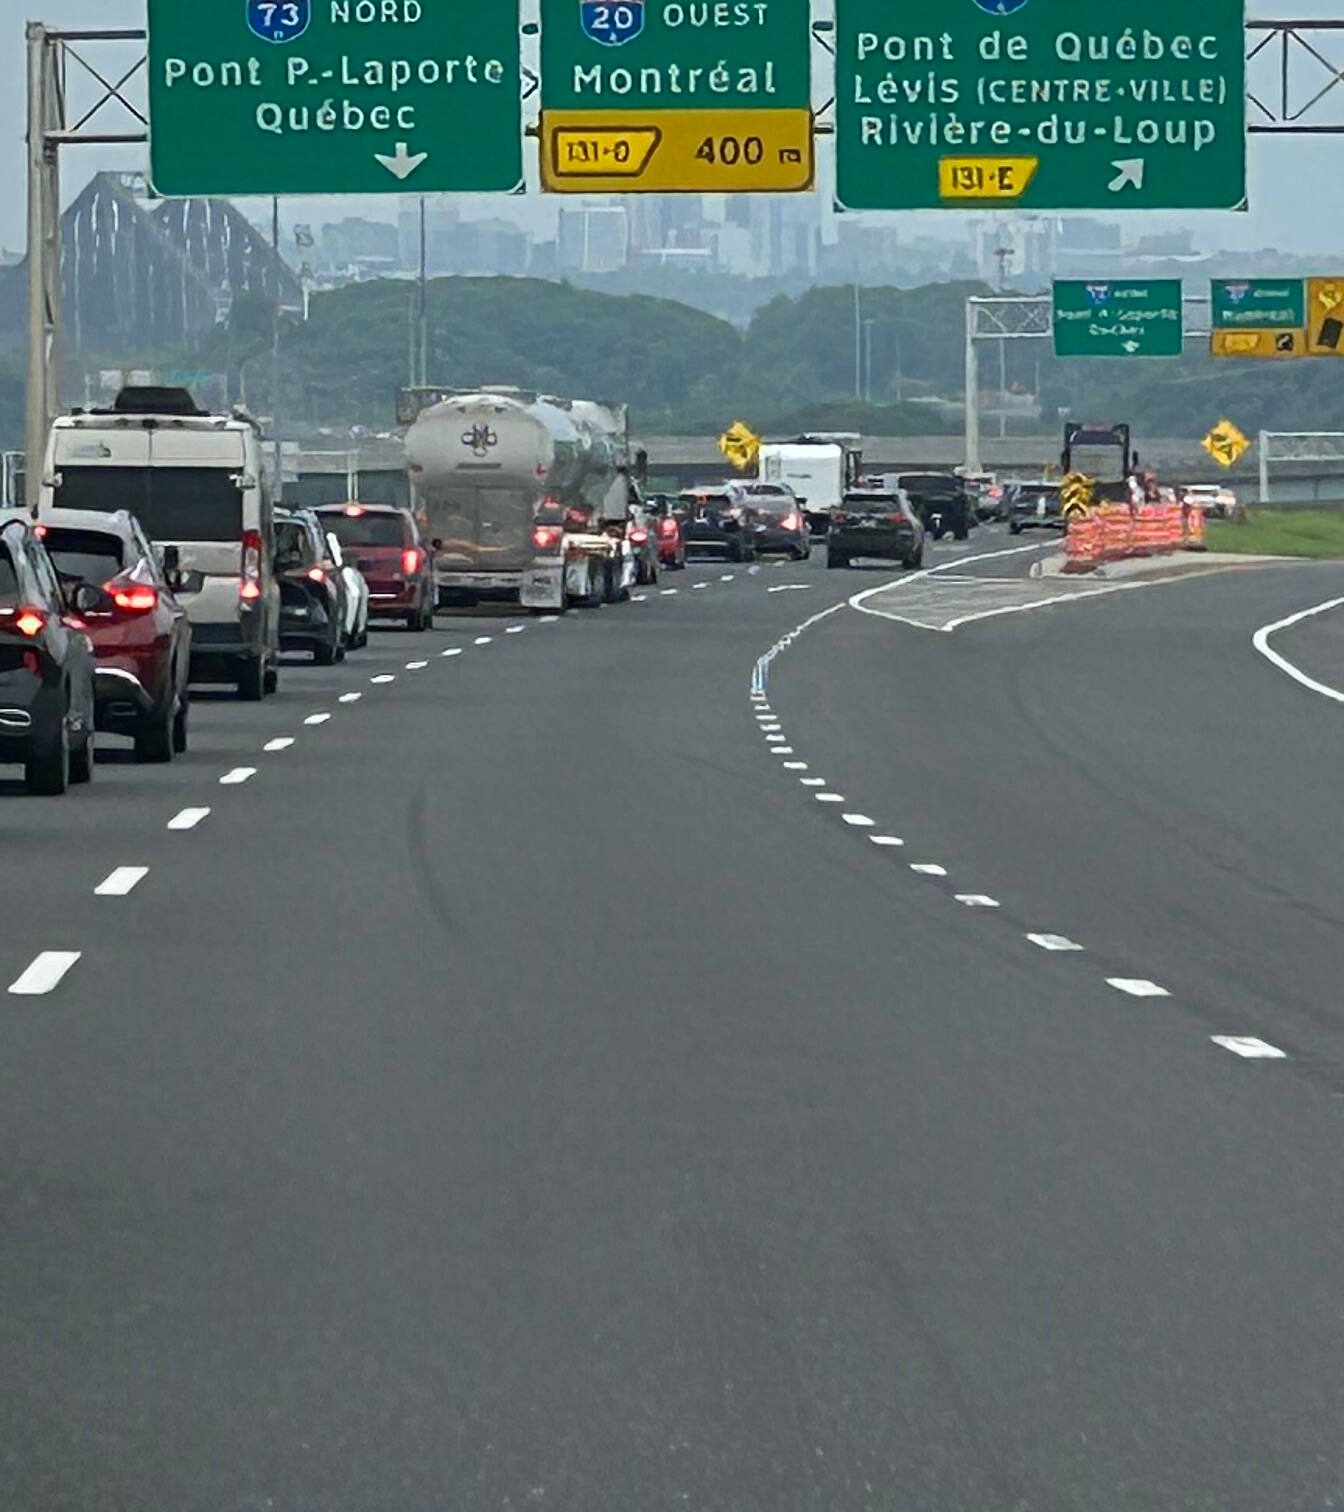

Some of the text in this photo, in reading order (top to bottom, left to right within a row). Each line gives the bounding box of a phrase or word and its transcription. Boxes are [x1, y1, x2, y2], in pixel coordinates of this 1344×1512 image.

[256, 2, 300, 27] 73
[591, 1, 768, 29] 20 OUEST
[856, 26, 1219, 63] Pont de Québec
[164, 54, 505, 92] Pont P.-Laporte
[572, 59, 777, 95] Montréal
[853, 71, 1227, 106] Lévis (CENTRE-VILLE)
[255, 98, 416, 135] Québec
[860, 112, 1217, 152] Rivière-du-Loup
[695, 136, 764, 165] 400
[951, 165, 1014, 191] 131-E
